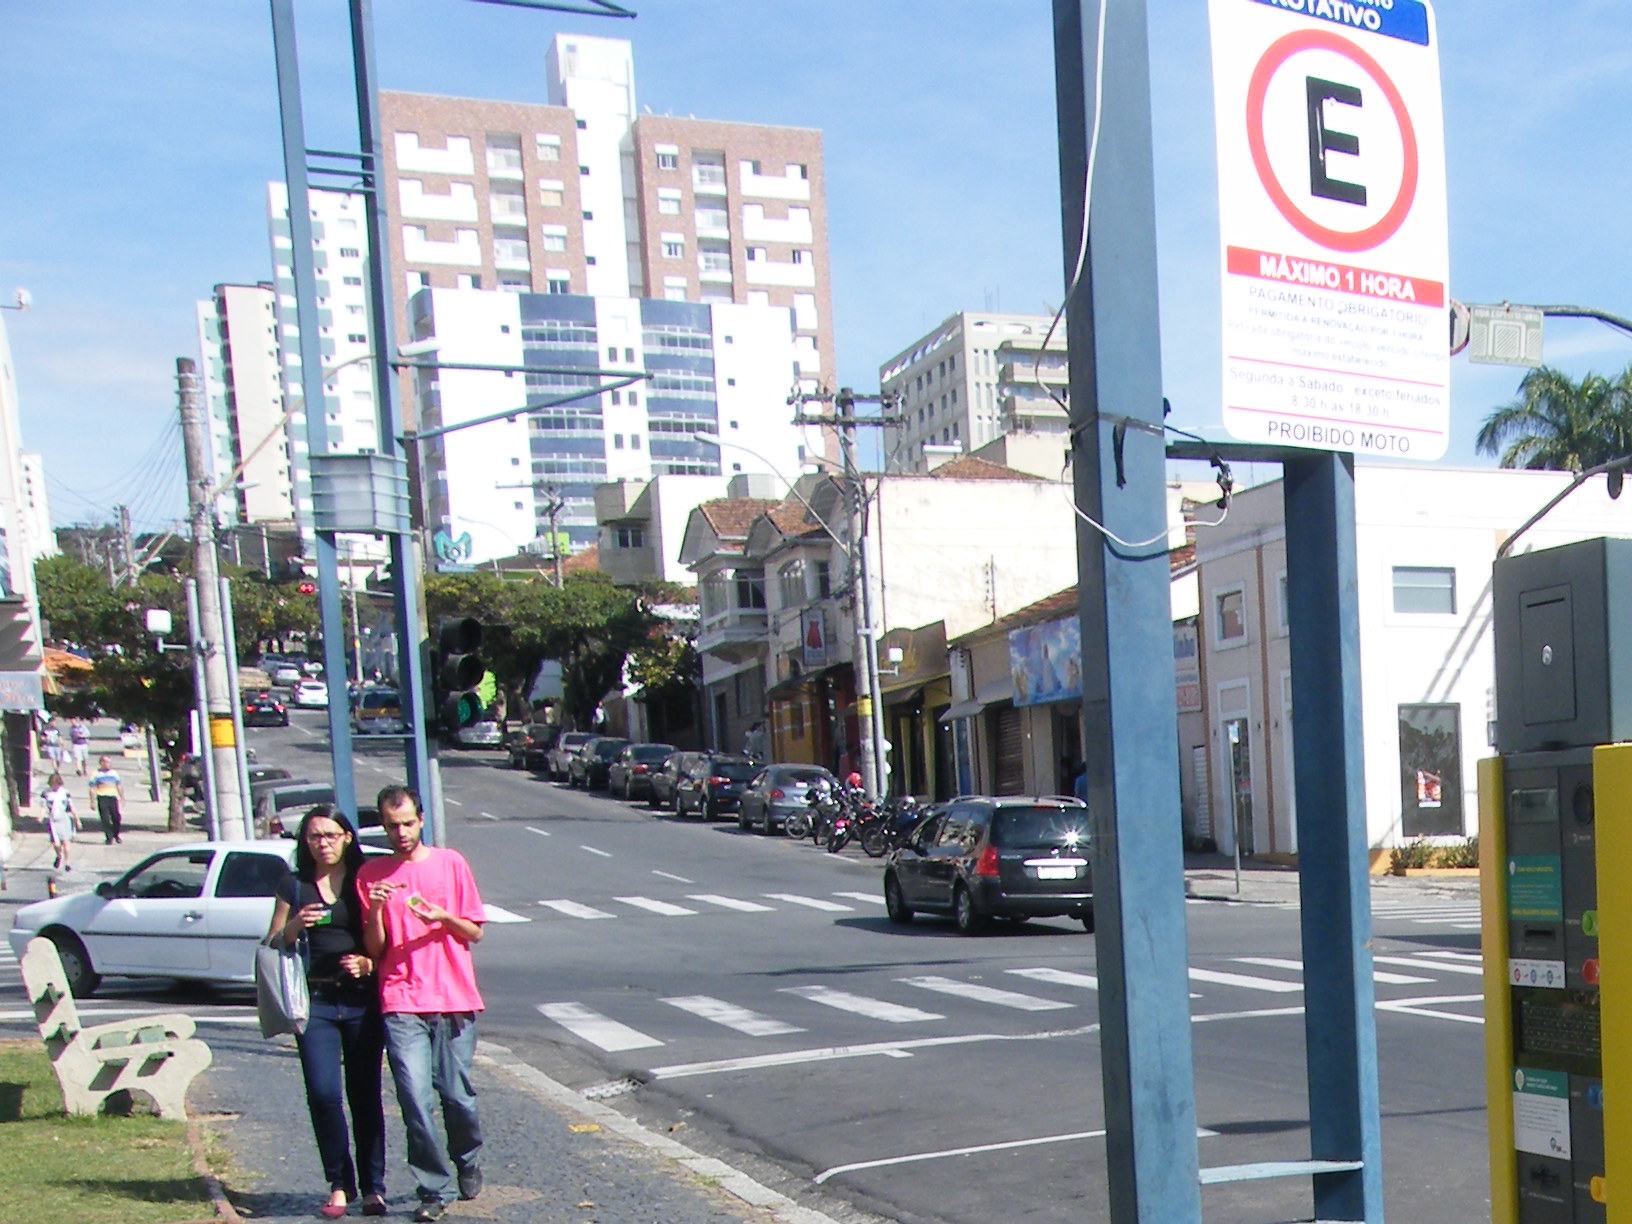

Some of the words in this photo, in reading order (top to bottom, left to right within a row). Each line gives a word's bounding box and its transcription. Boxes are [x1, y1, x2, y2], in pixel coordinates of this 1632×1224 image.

[1306, 75, 1367, 207] E
[1259, 255, 1340, 287] MÁXIMO
[1346, 271, 1355, 288] 1
[1361, 273, 1416, 301] HORA
[1249, 286, 1334, 311] PAGAMENTO
[1229, 366, 1284, 386] Segunda
[1288, 377, 1294, 387] a
[1268, 420, 1355, 447] PROIBIDO
[1360, 431, 1410, 453] MOTO
